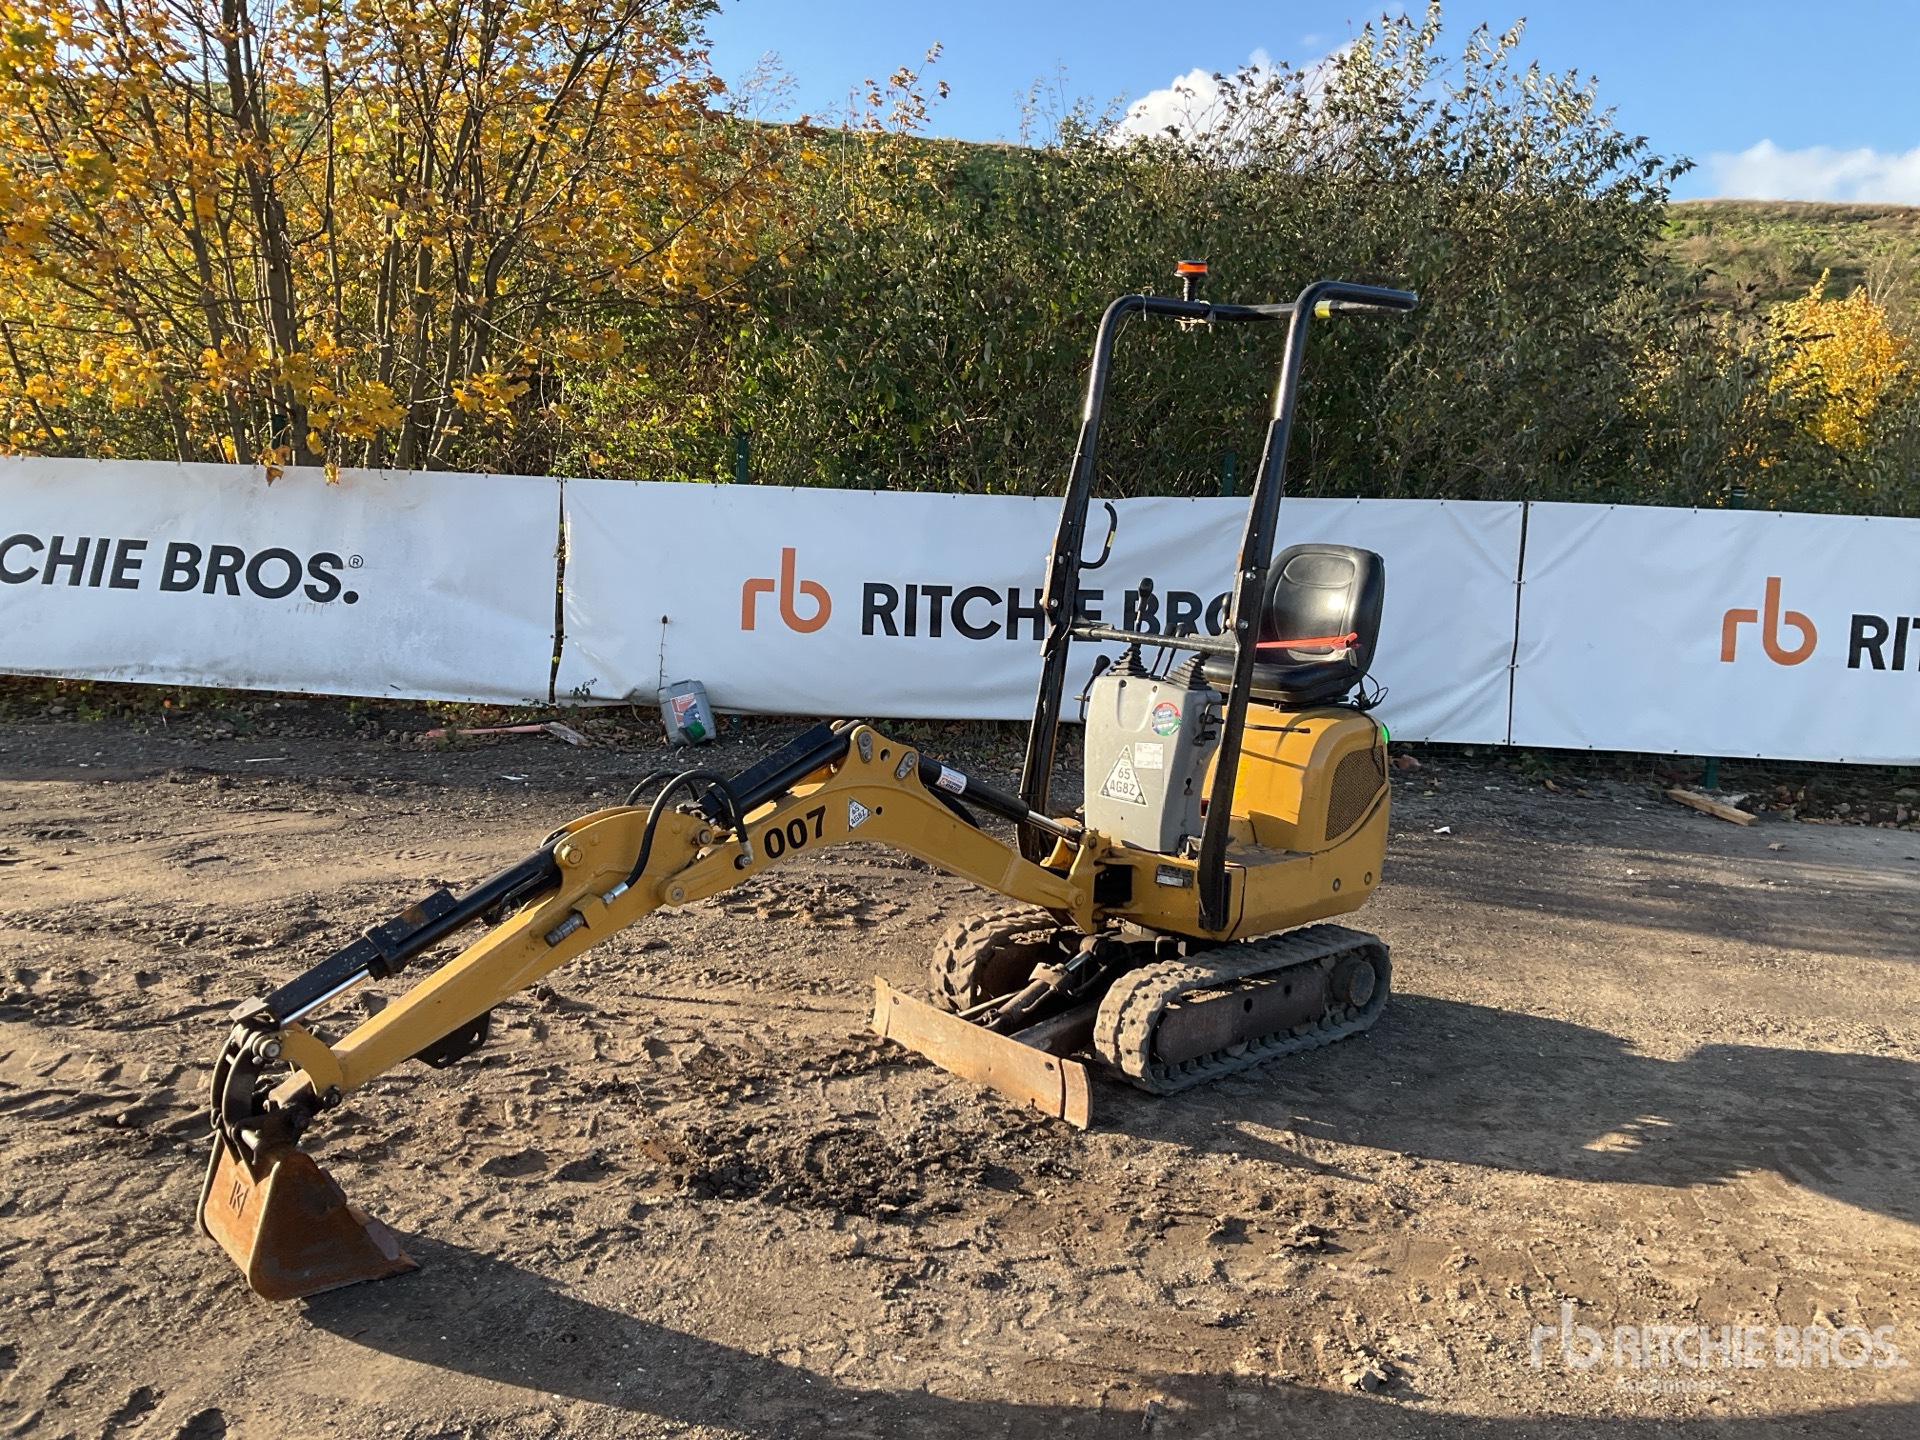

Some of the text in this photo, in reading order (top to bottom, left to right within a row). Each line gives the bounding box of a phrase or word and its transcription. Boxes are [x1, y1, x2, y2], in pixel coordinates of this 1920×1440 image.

[0, 533, 148, 590] CHIE
[741, 547, 832, 634] rb
[861, 582, 1104, 642] RITCHE
[1720, 576, 1920, 672] rb RI
[1110, 779, 1136, 796] AG8Z
[1118, 767, 1131, 780] 65
[764, 805, 826, 859] 007
